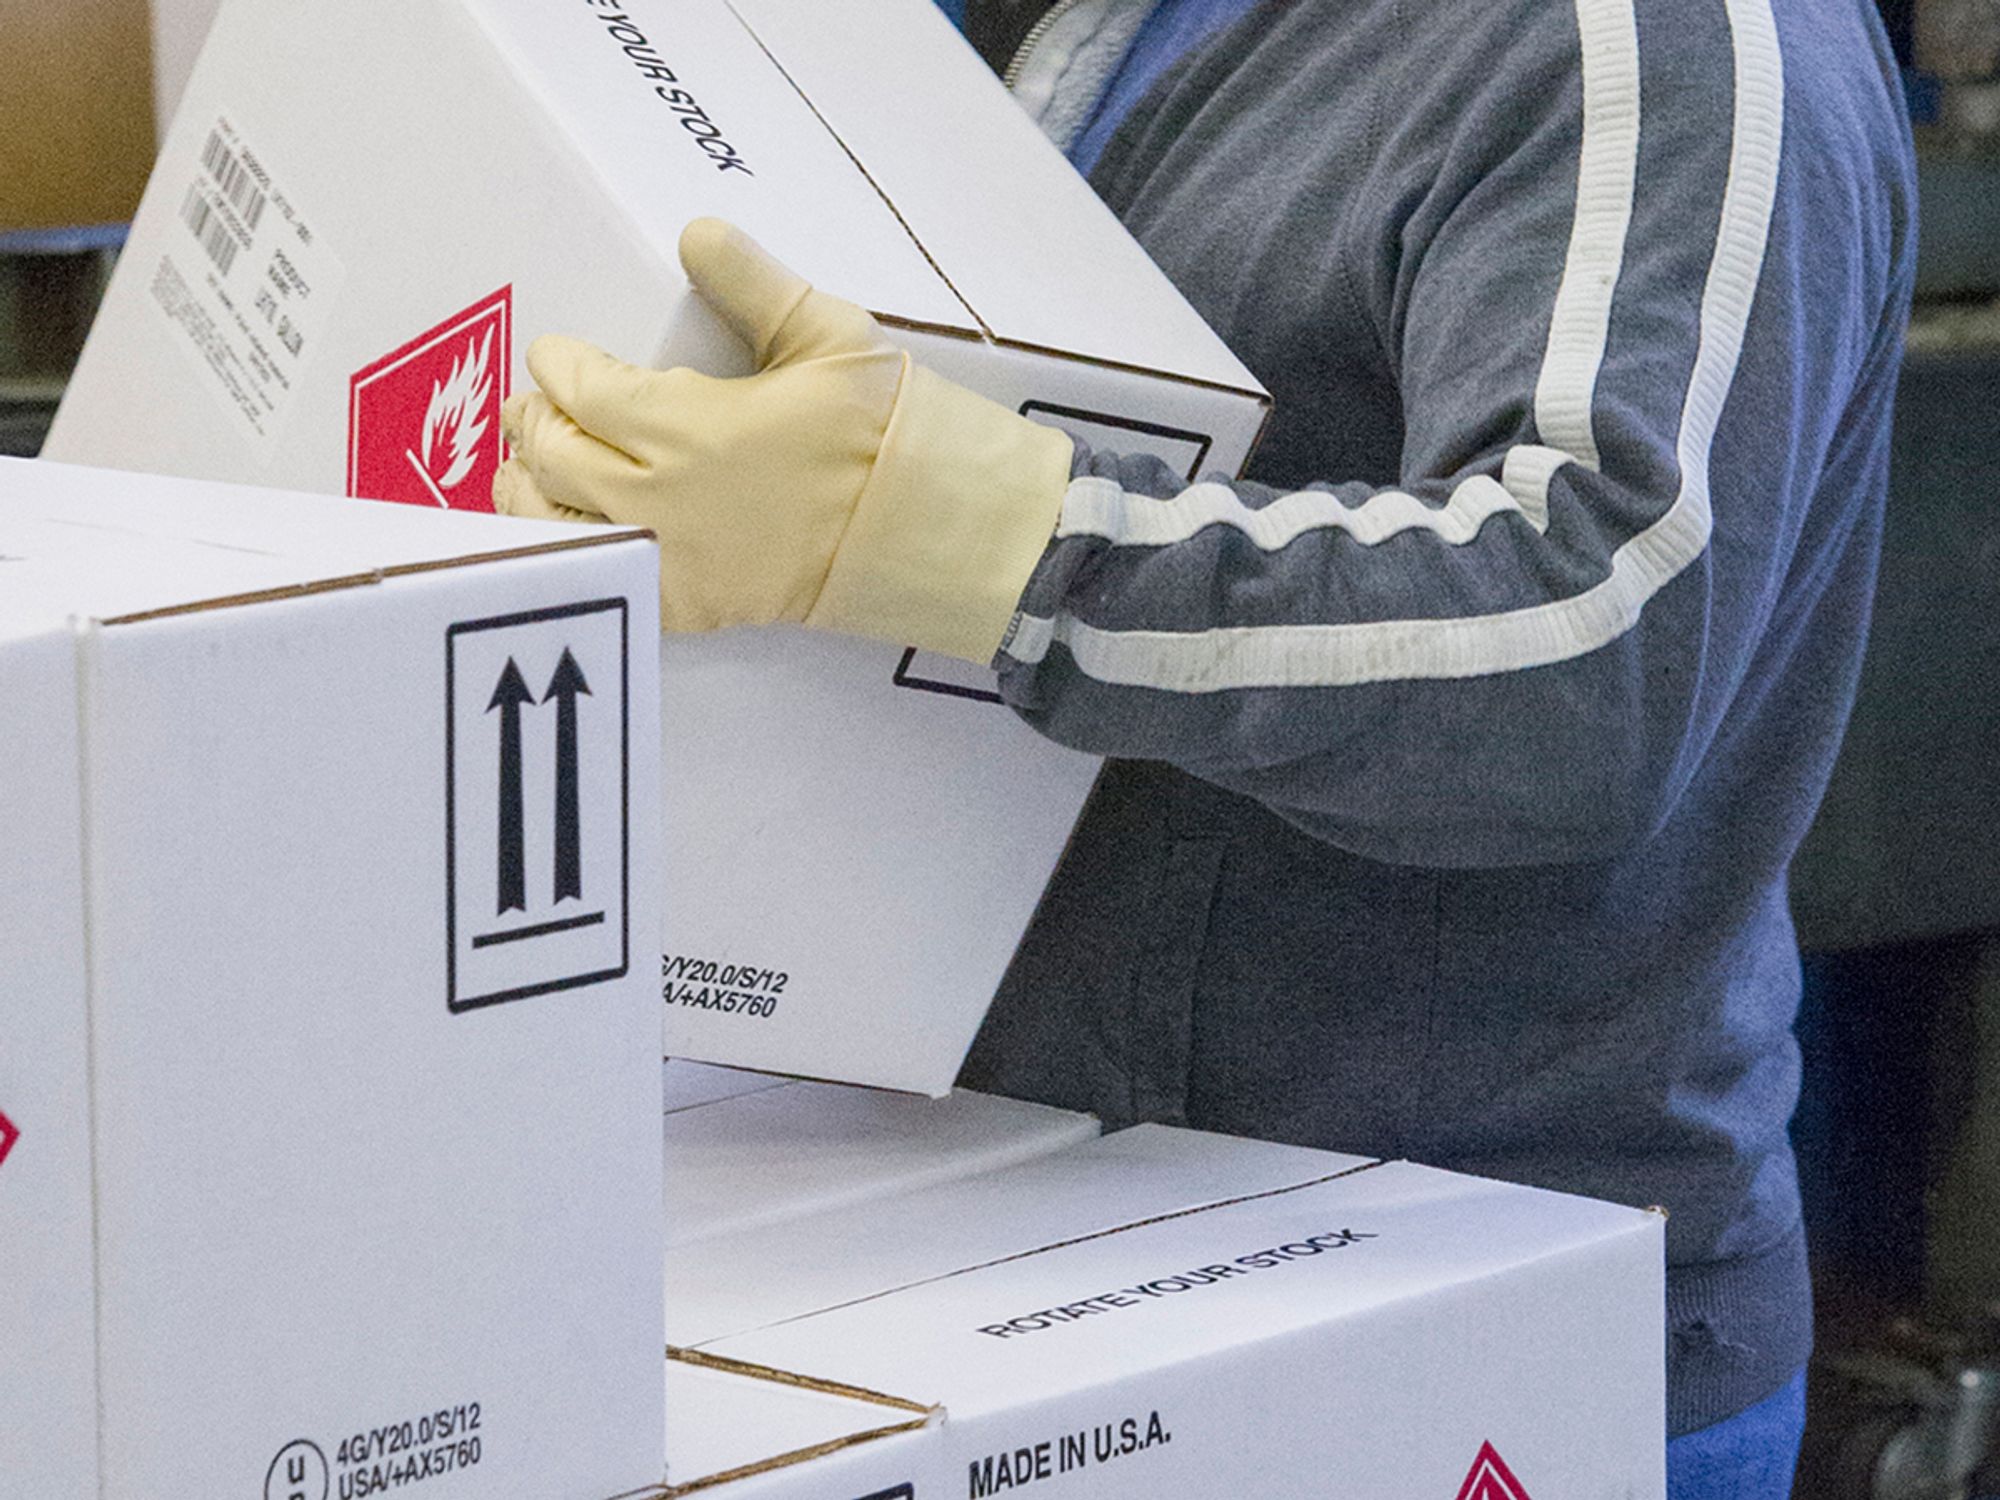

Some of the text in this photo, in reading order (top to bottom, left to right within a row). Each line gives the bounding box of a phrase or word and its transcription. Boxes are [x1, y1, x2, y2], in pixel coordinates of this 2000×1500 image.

[598, 14, 754, 177] YOUR STOCK
[977, 1228, 1379, 1339] ROTATE YOUR STOCK
[337, 1402, 481, 1466] 4G/Y20.0/S/12
[969, 1411, 1171, 1500] MADE IN U.S.A.
